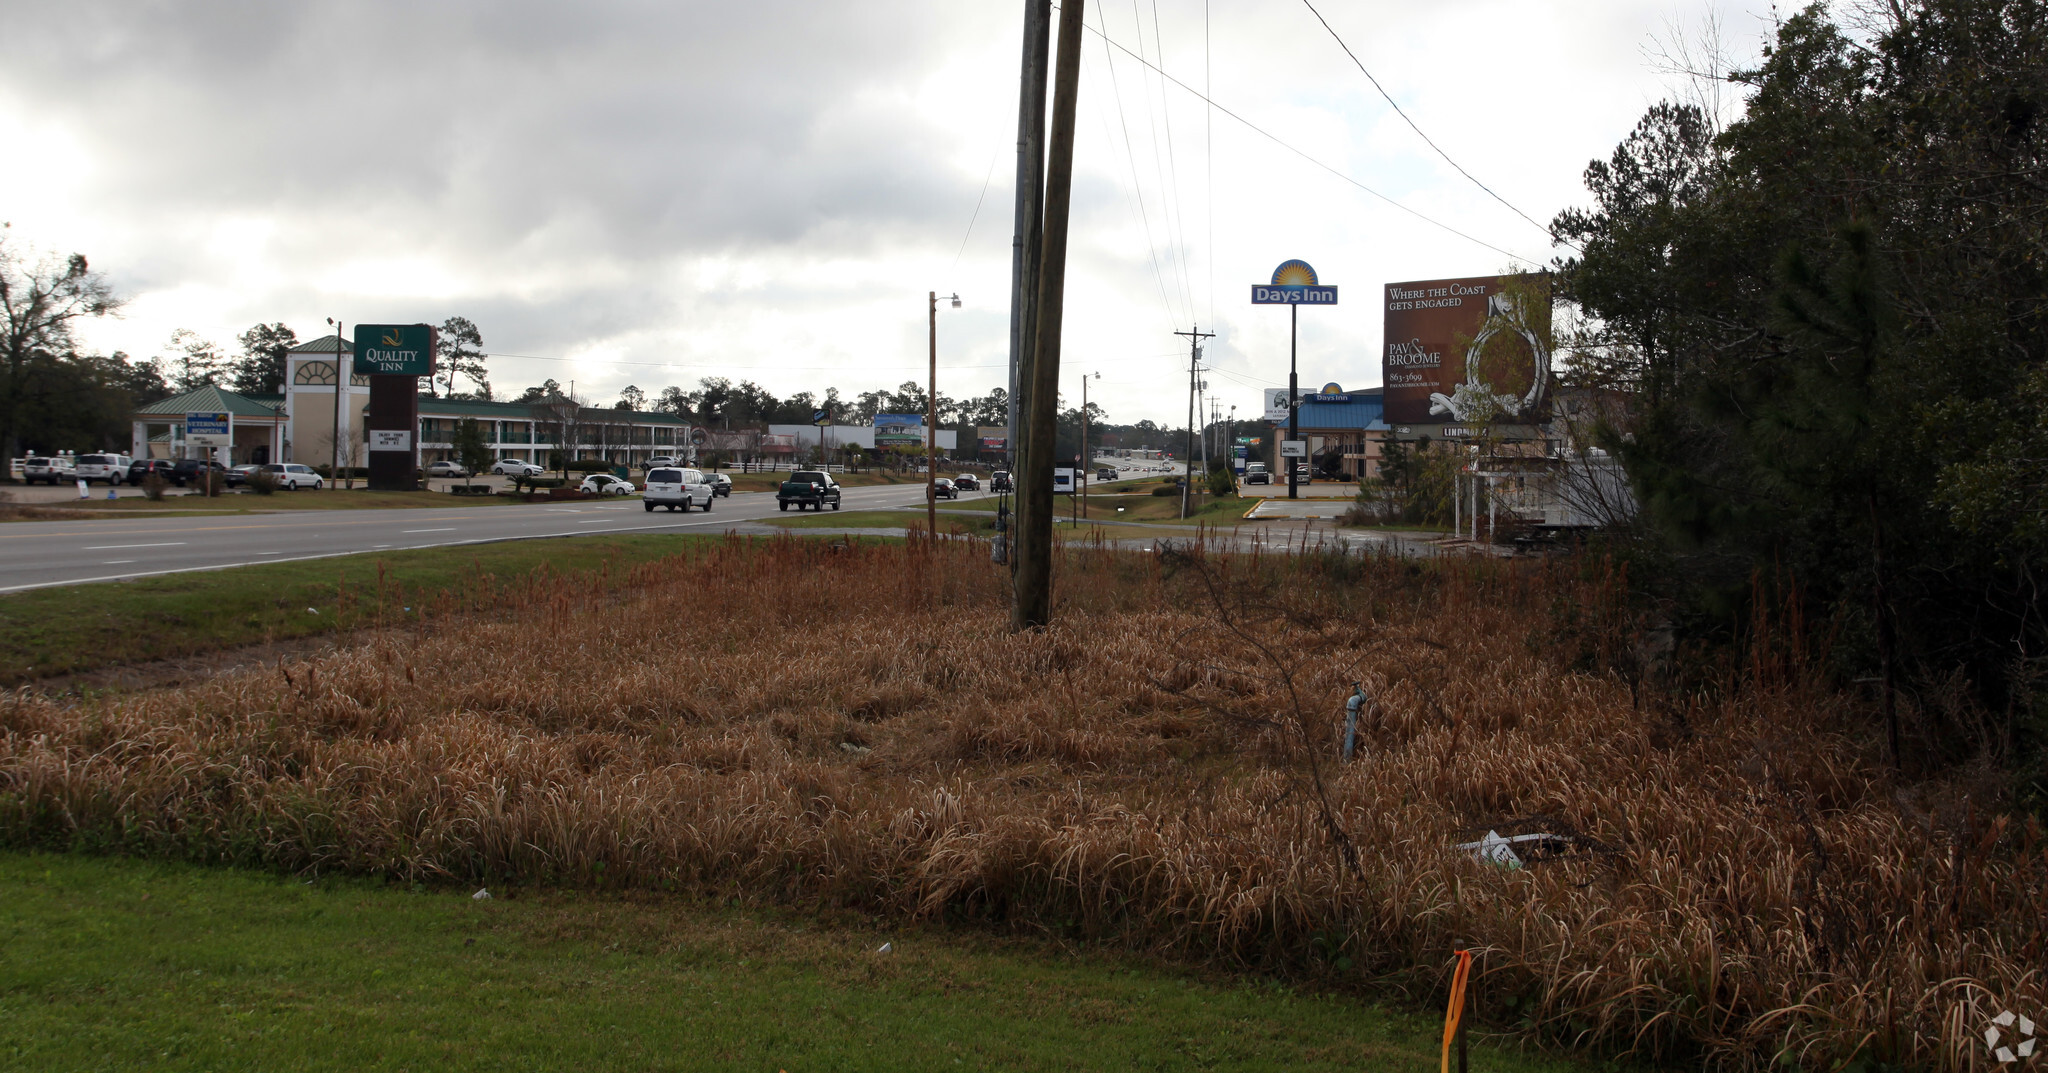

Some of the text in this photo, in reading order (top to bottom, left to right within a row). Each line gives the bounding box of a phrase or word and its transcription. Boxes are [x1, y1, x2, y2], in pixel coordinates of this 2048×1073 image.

[1256, 288, 1333, 303] Days Inn
[1389, 283, 1486, 300] WHERE THE COAST
[1389, 298, 1462, 311] GETS ENGAGED
[1389, 343, 1410, 354] PAV
[366, 348, 418, 363] QUALITY
[1389, 352, 1441, 366] BROOME
[380, 362, 404, 371] INN
[1389, 372, 1422, 382] 863-3699
